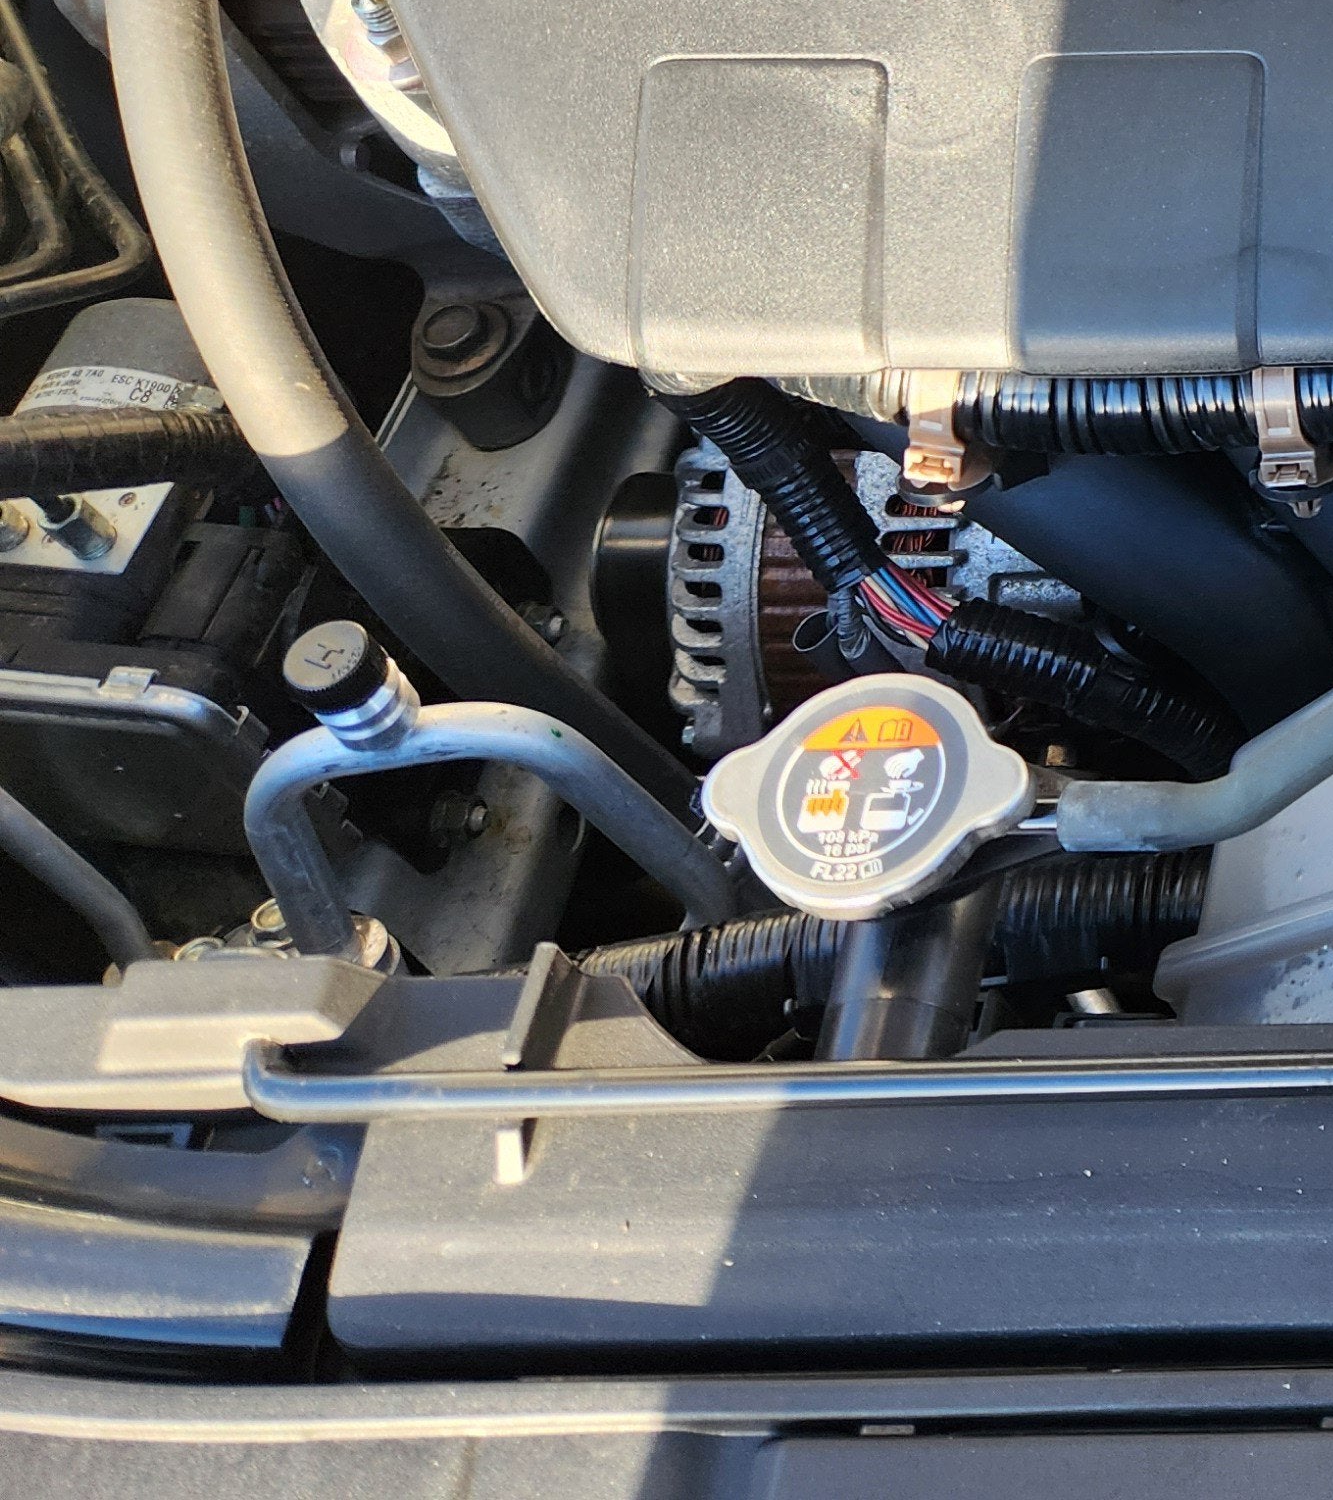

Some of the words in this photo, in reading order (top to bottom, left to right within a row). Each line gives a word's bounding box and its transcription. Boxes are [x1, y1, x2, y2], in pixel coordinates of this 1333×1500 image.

[110, 374, 133, 385] ESC
[129, 387, 151, 404] C8
[809, 860, 858, 881] FL22
